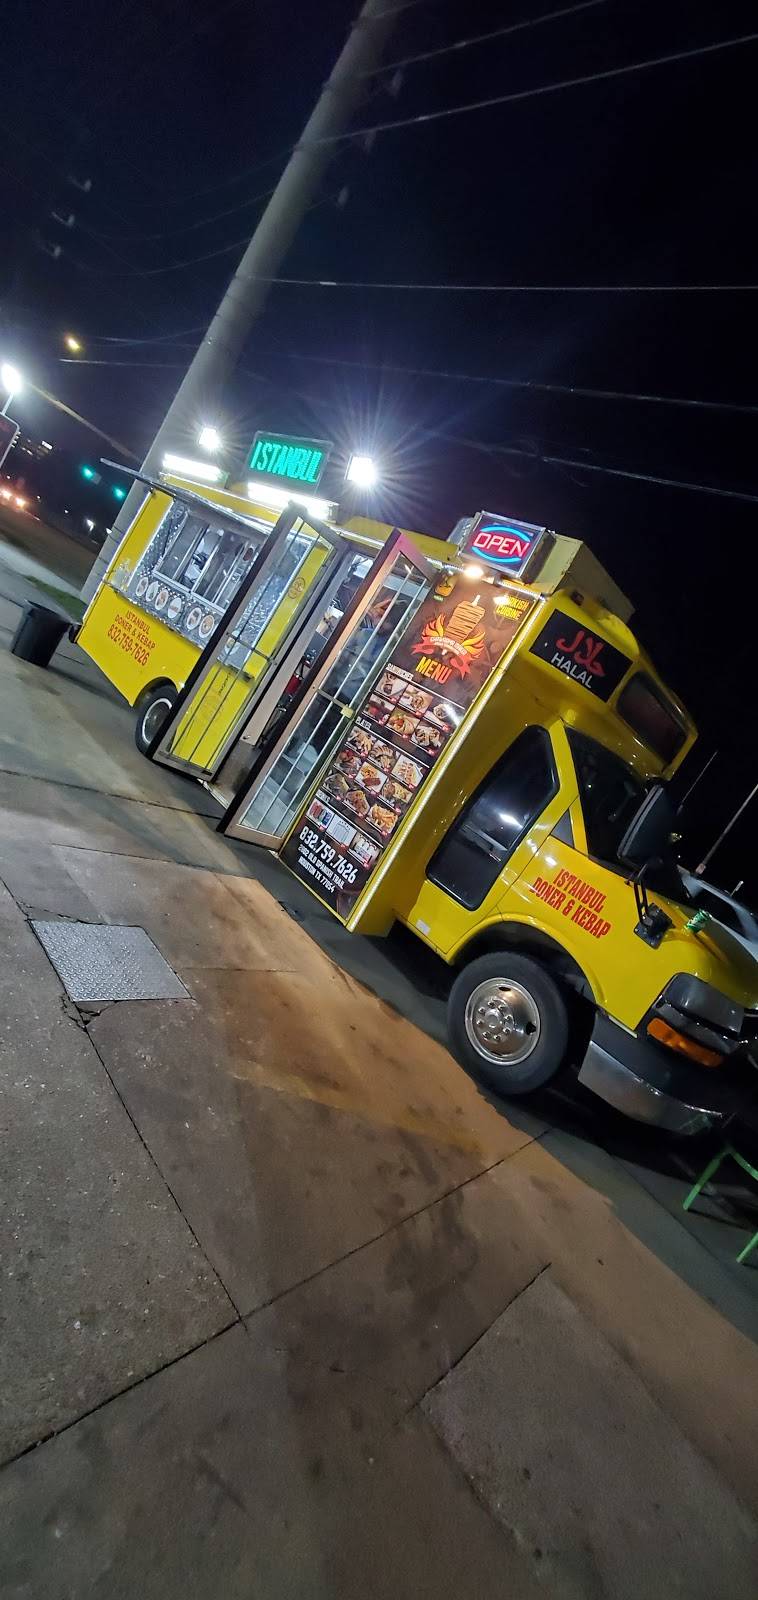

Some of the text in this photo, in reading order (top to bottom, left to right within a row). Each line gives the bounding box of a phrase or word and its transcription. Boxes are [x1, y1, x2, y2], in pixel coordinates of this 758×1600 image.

[250, 441, 322, 482] ISTANBUL
[473, 532, 530, 557] OPEN
[126, 610, 151, 635] ISTANBUL
[131, 628, 137, 636] &
[137, 632, 156, 650] KEBAP
[415, 656, 453, 684] MENU
[551, 652, 593, 689] HALAL
[300, 826, 358, 884] 832.759.7626
[314, 870, 323, 881] TX
[332, 873, 346, 890] TRAIL
[553, 869, 607, 913] ISTANBUL
[530, 877, 612, 938] DONER & KEBAP
